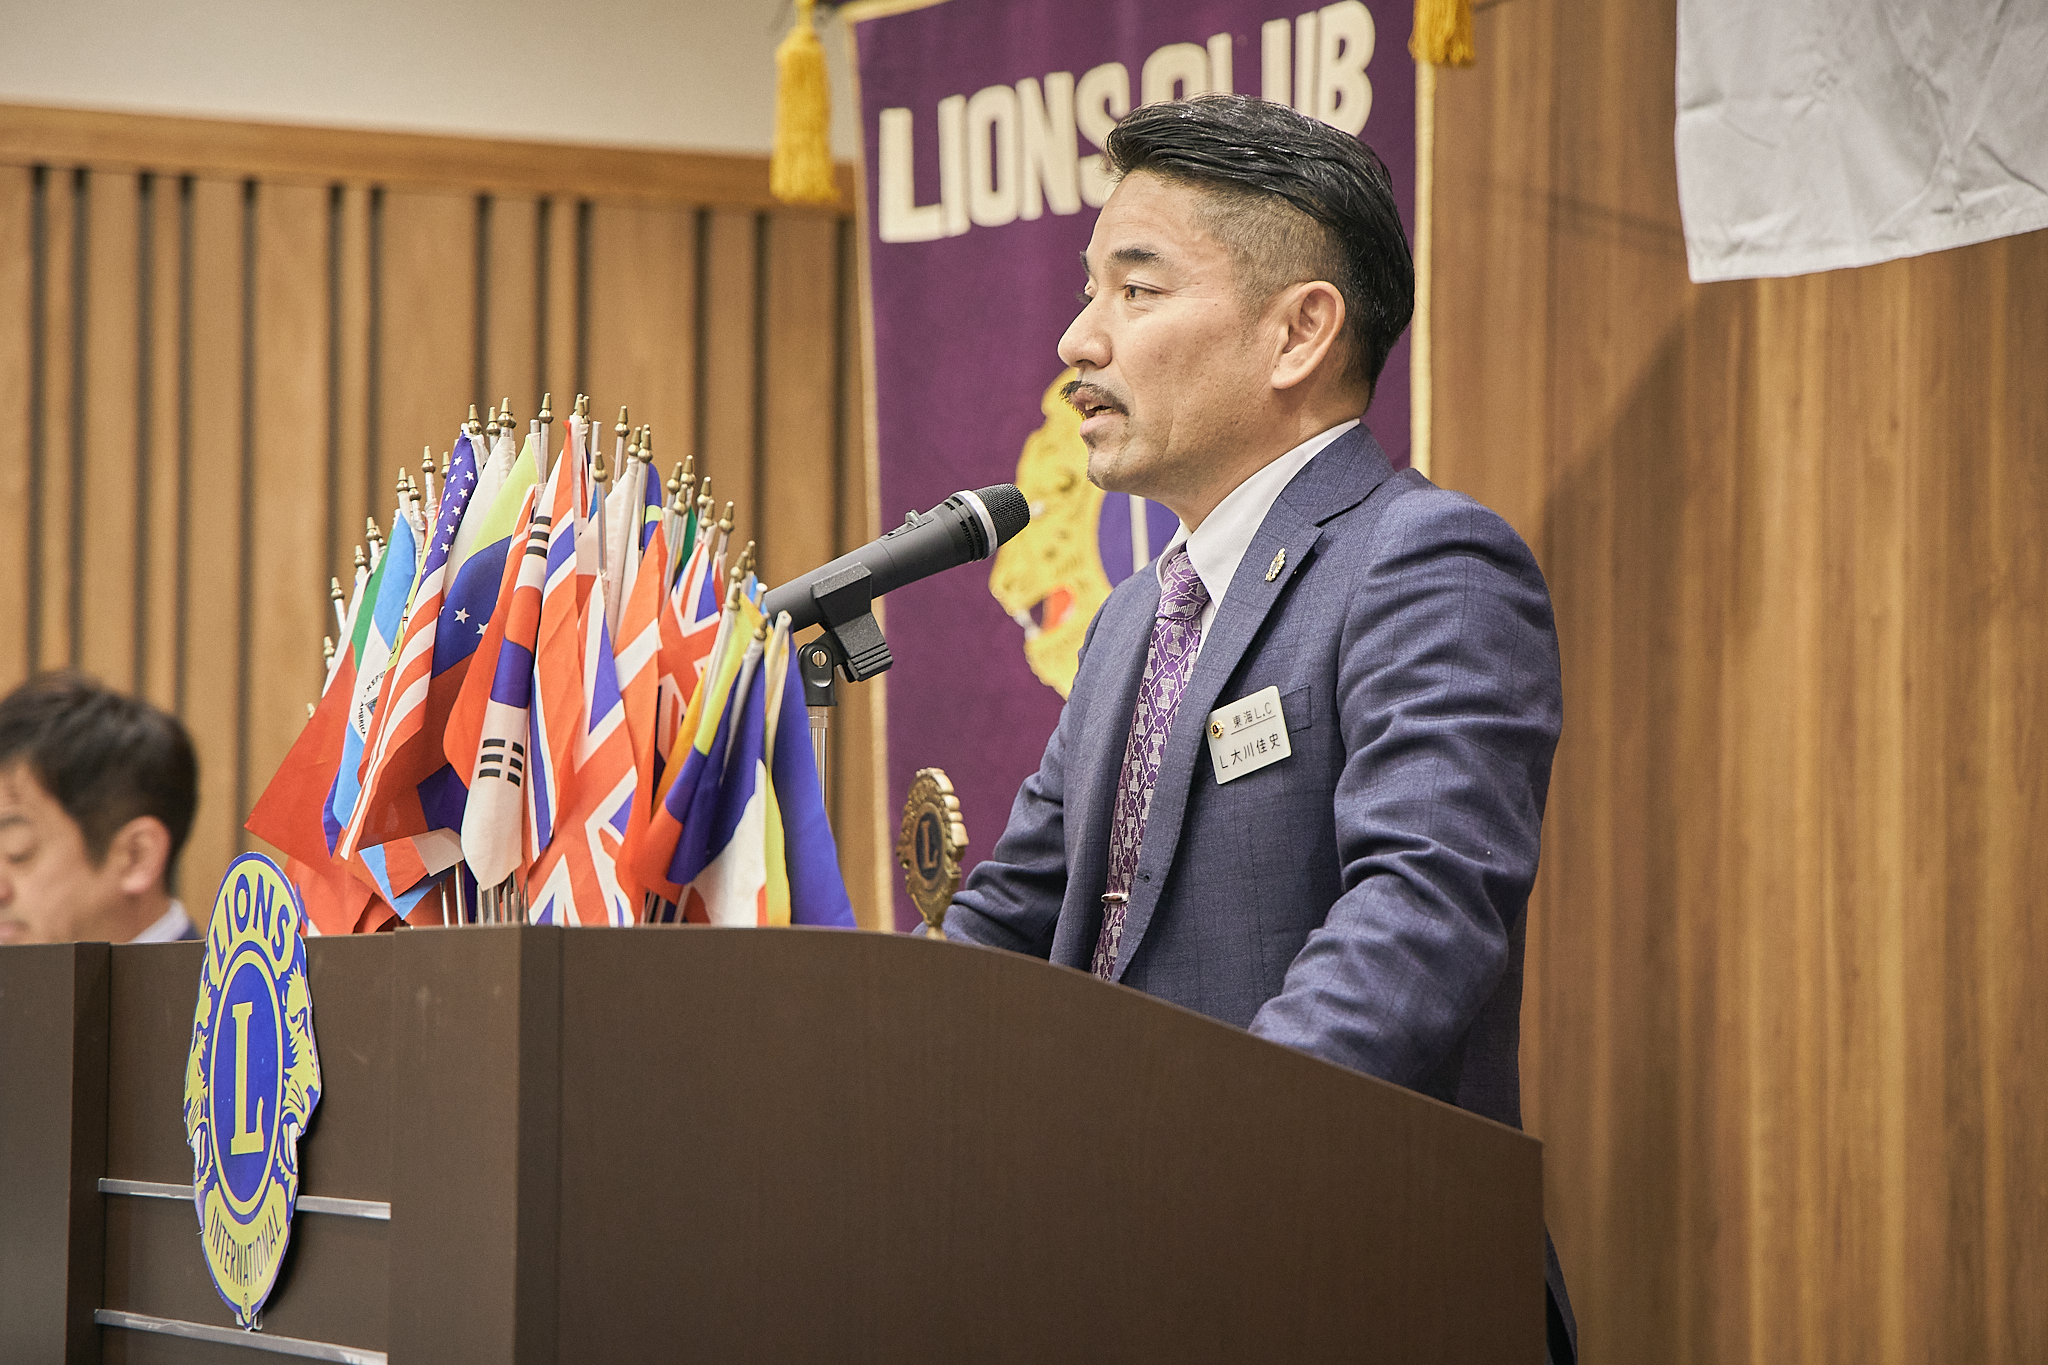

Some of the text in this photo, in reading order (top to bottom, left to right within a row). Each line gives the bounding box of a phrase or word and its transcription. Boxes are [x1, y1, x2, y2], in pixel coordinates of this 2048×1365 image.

[879, 62, 1130, 243] LIONS
[212, 873, 291, 975] LIONS
[230, 1001, 265, 1156] L
[209, 1204, 282, 1288] INTERNATIONAL
